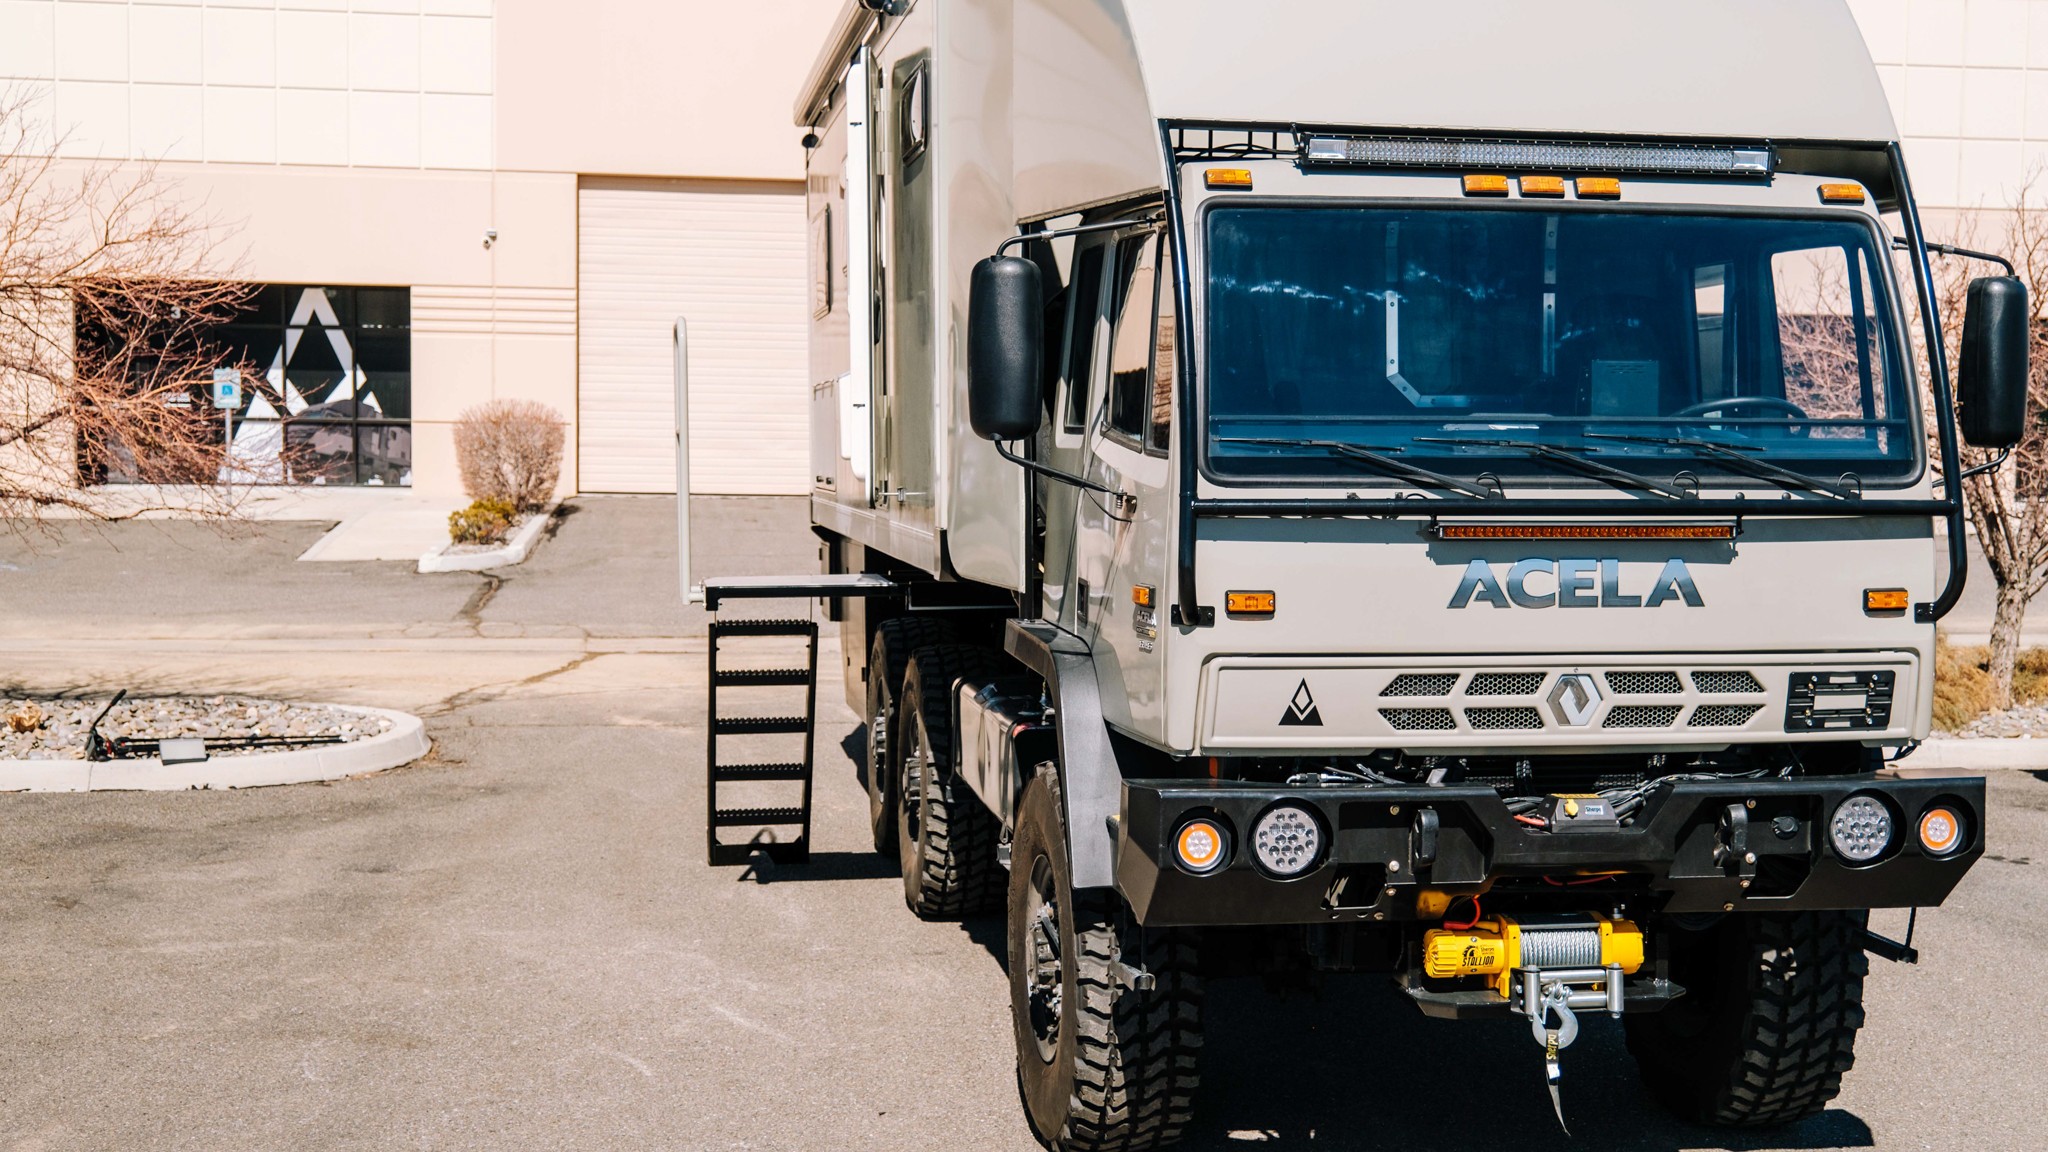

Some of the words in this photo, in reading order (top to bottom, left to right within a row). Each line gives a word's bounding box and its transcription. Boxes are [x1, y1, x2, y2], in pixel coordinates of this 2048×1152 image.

[1447, 557, 1706, 609] ACELA
[1462, 956, 1495, 967] STALLION
[1547, 1034, 1558, 1060] Sherpa
